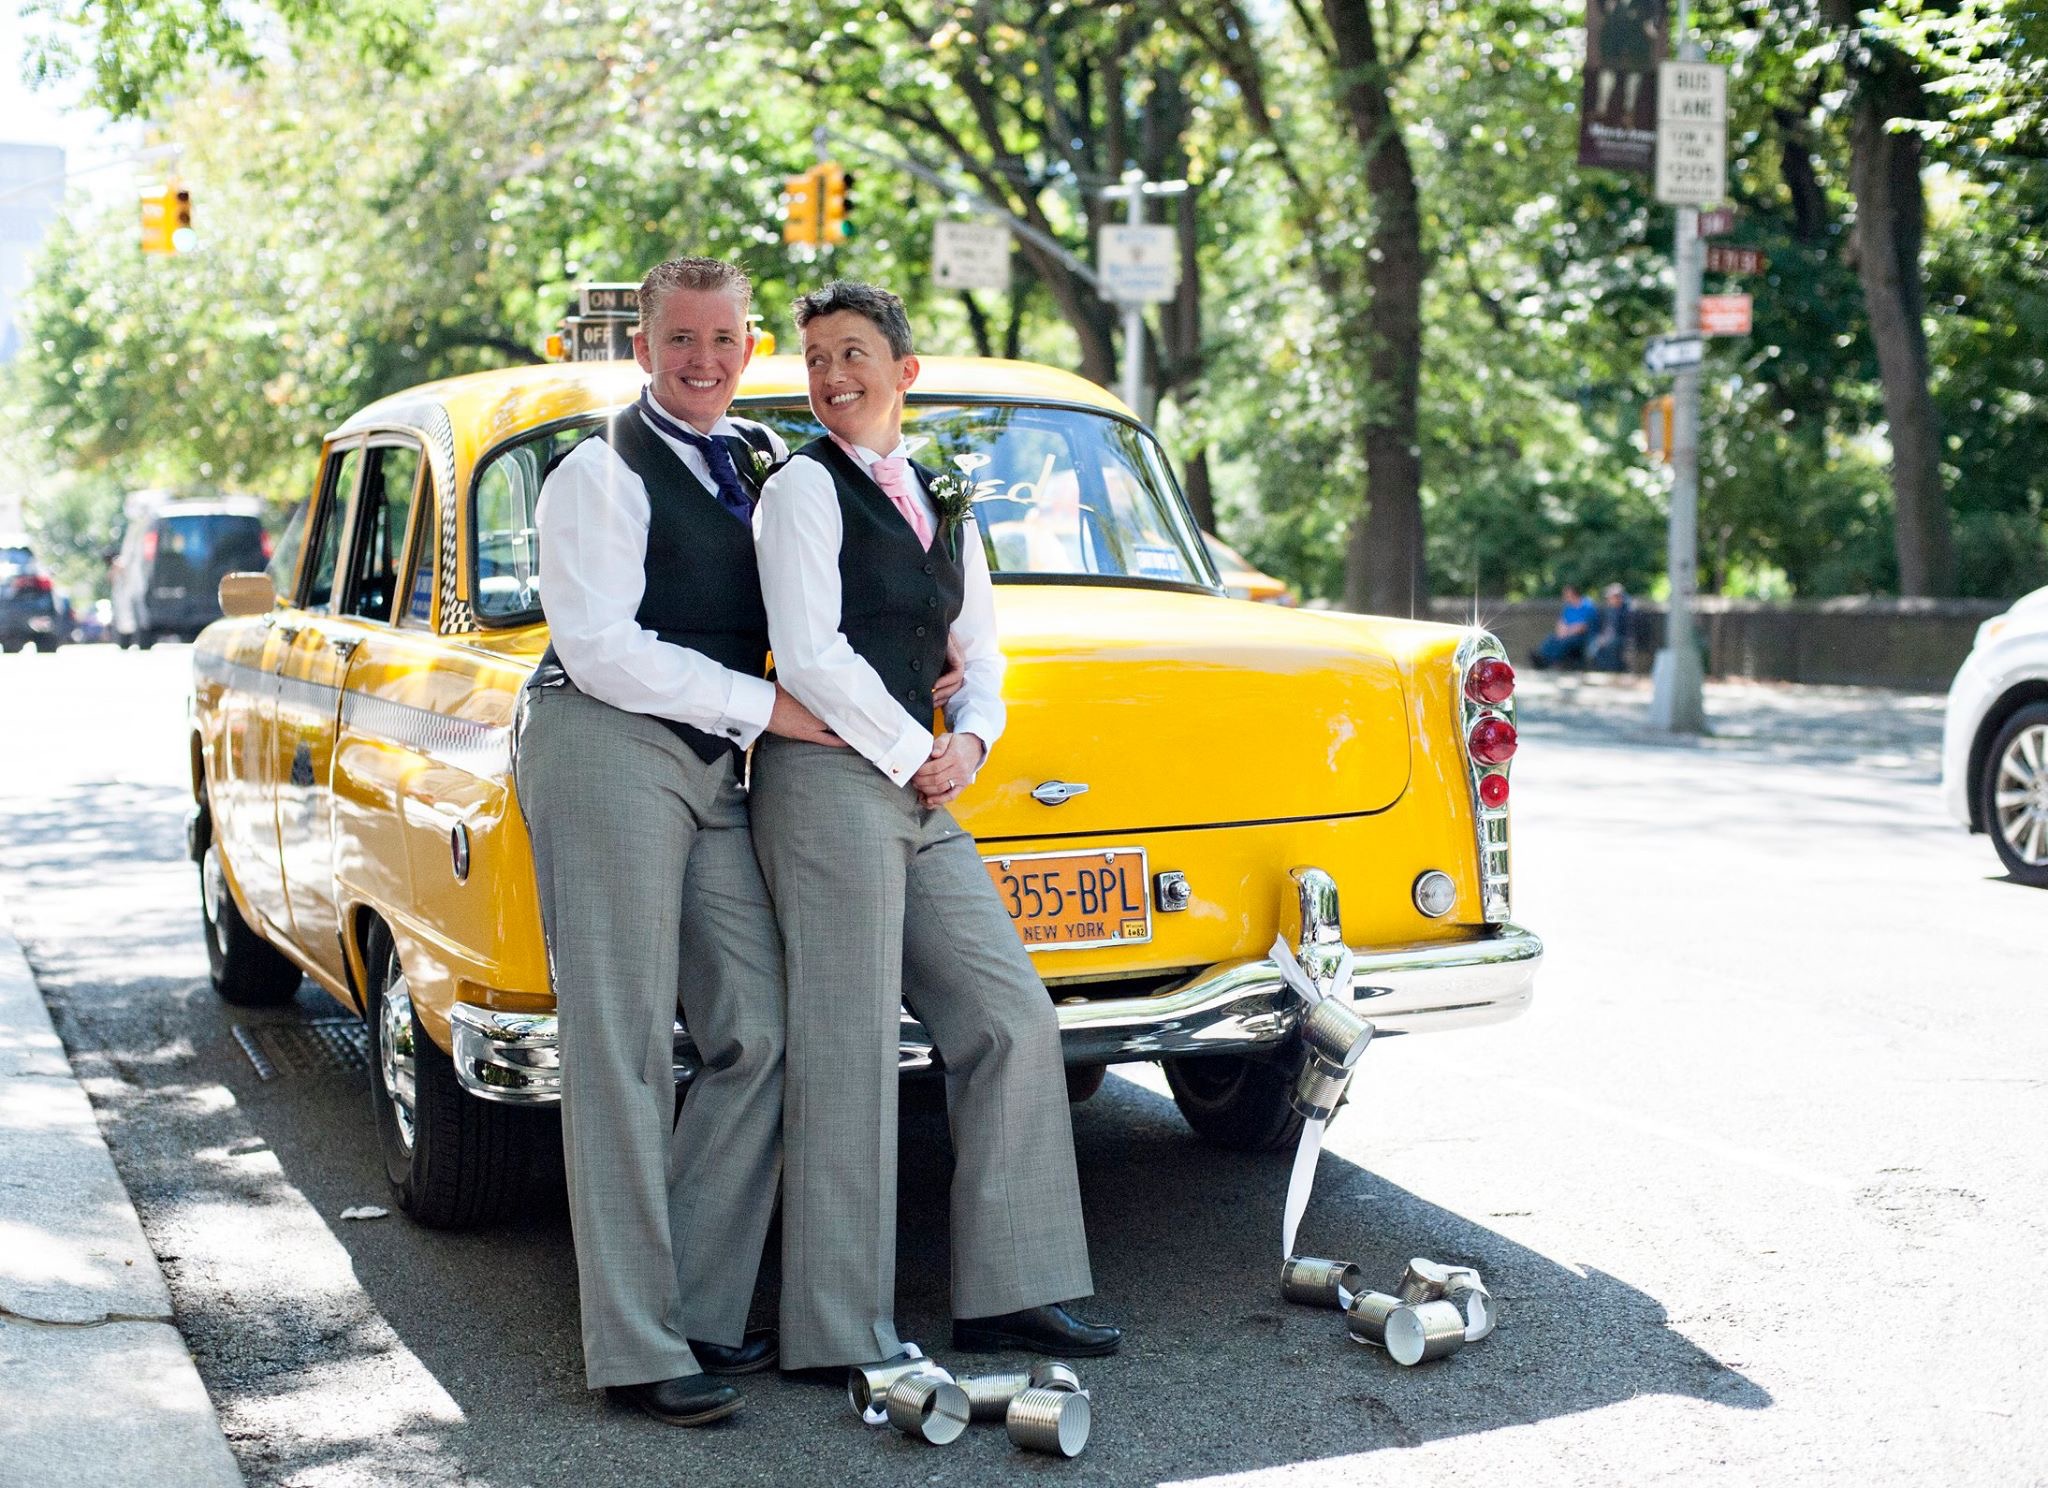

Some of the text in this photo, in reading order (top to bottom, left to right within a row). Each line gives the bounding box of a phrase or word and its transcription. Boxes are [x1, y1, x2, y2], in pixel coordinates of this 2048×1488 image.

[1675, 72, 1711, 91] BUS
[1670, 99, 1713, 117] LANE
[591, 291, 616, 307] ON
[583, 327, 613, 343] OFF
[1001, 867, 1140, 919] 355-BPL
[1023, 921, 1106, 941] NEW YORK
